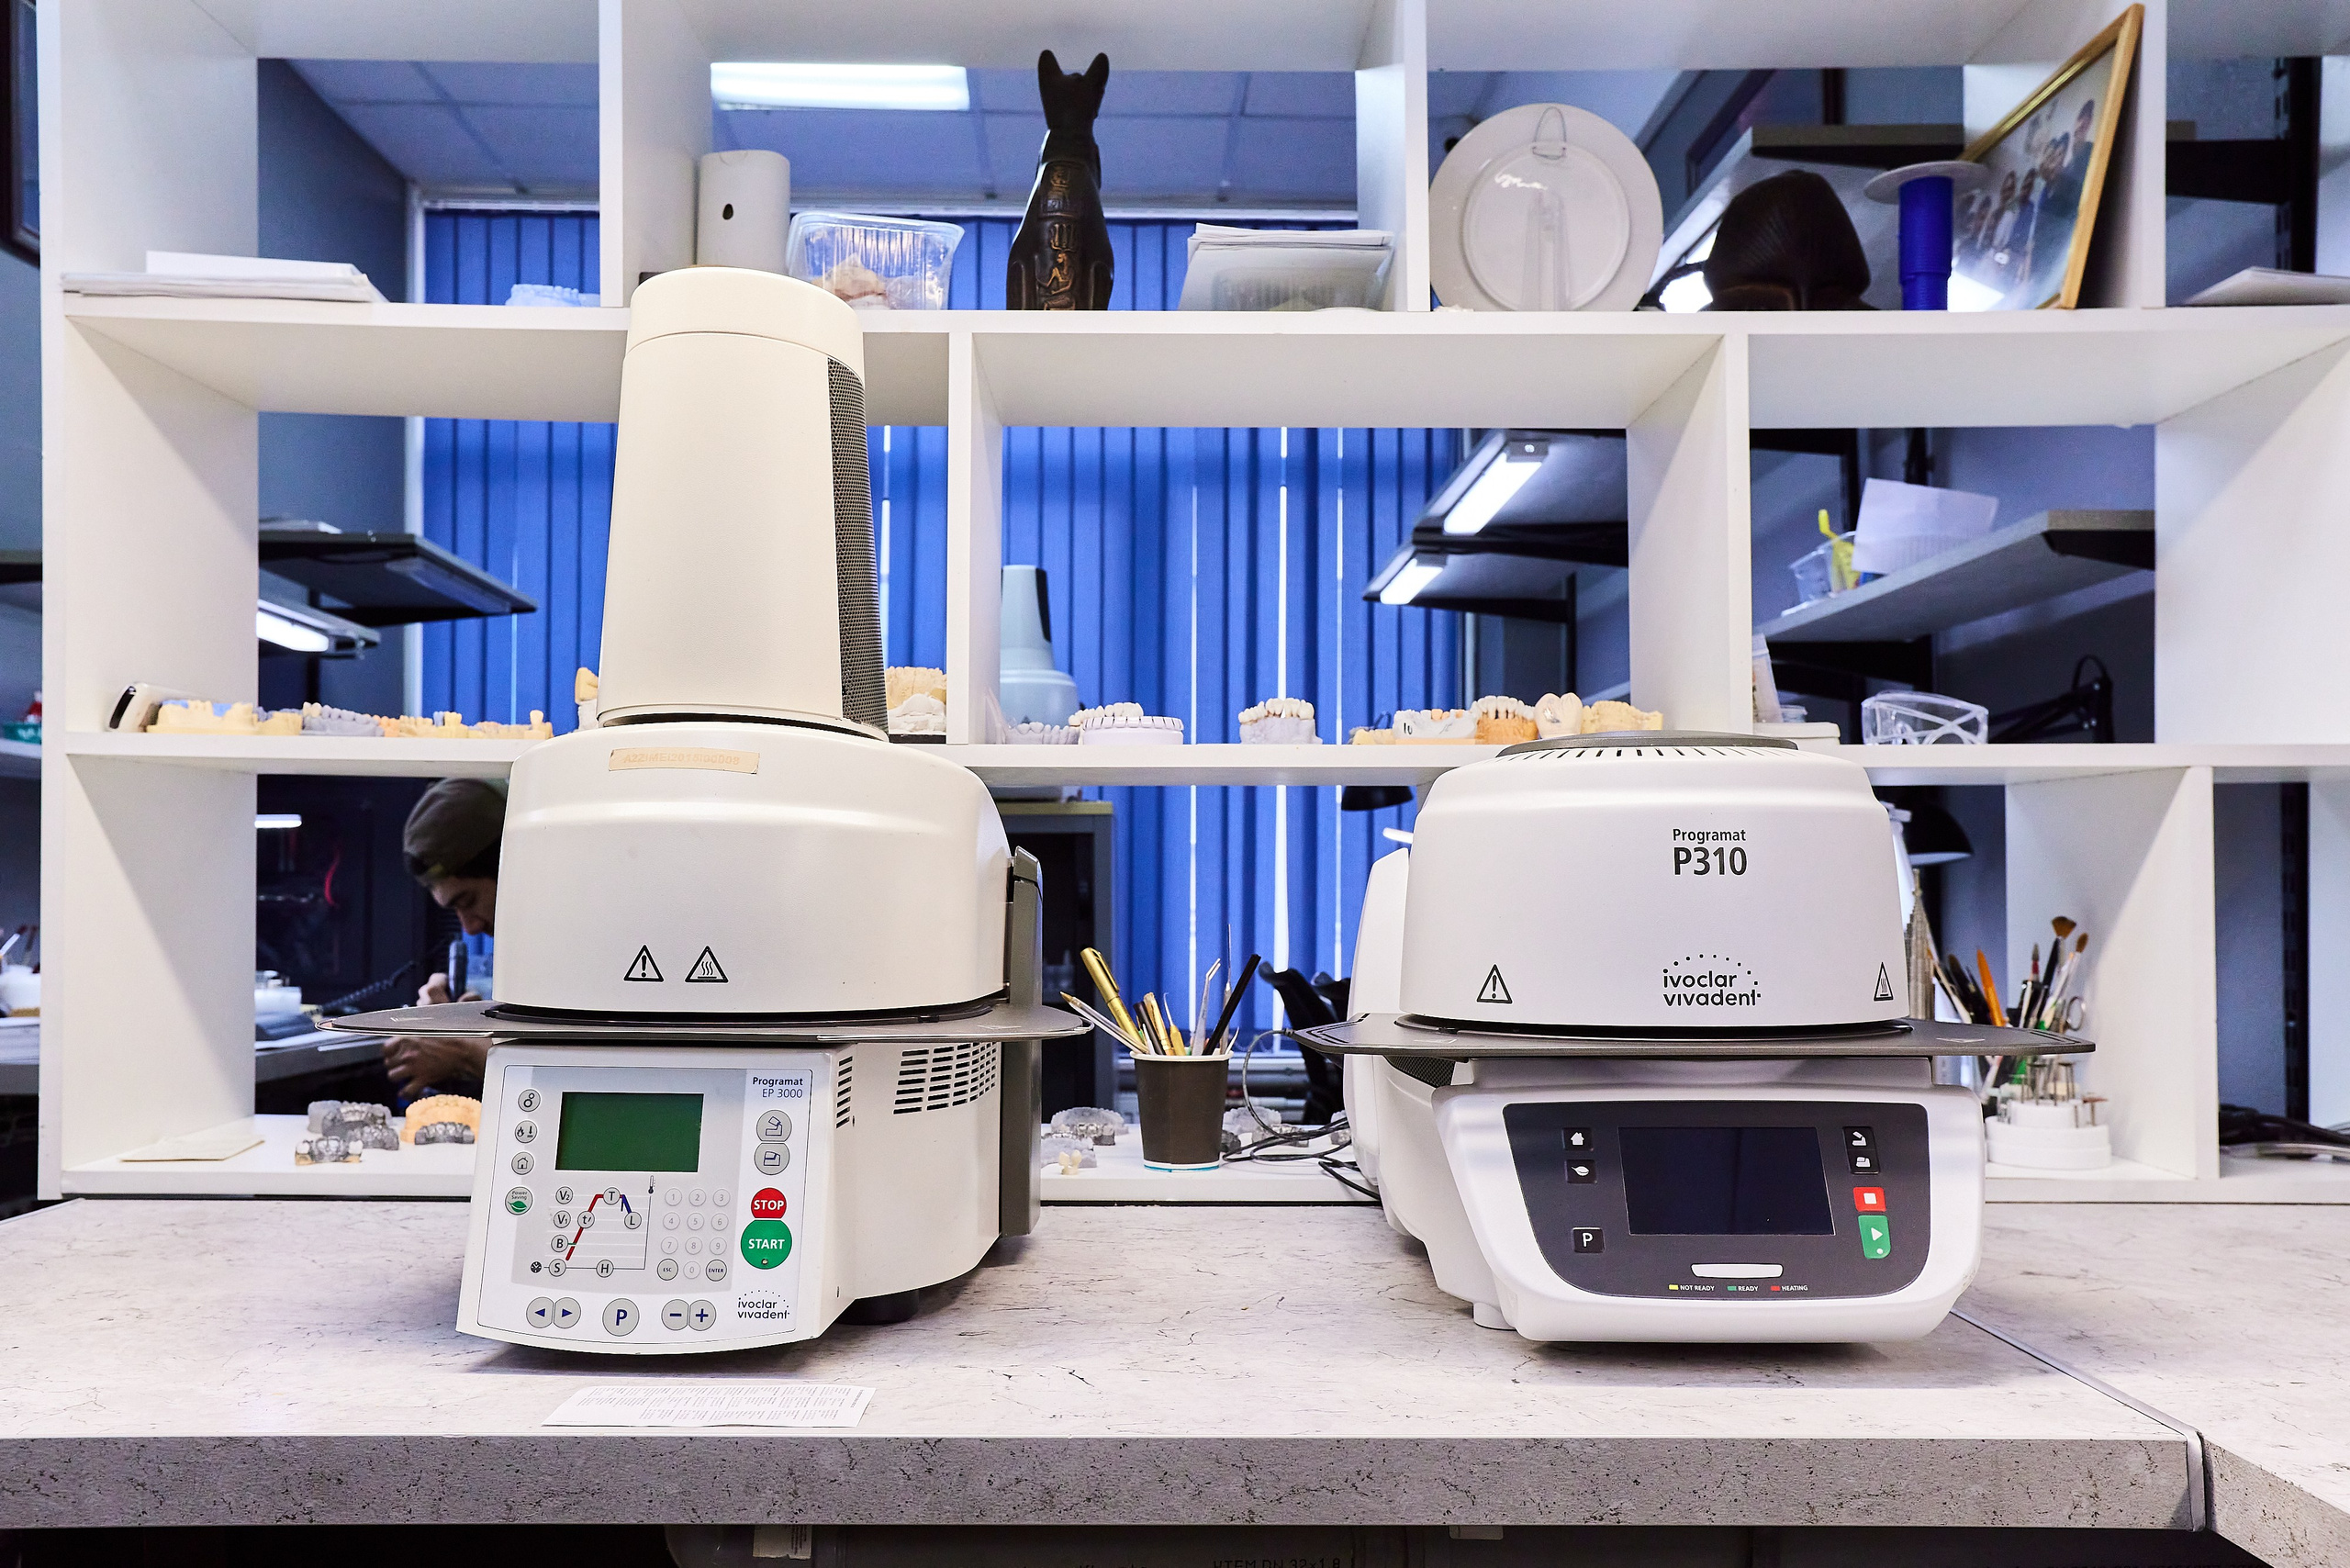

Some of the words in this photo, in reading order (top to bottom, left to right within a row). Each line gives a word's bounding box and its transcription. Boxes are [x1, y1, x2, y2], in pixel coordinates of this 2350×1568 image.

[1673, 828, 1747, 845] Programat
[1673, 846, 1748, 876] P310
[1662, 969, 1738, 988] ivoclar
[1662, 989, 1757, 1006] vivadent
[753, 1077, 803, 1087] Programat
[762, 1088, 775, 1098] EP
[777, 1088, 803, 1098] 3000
[609, 1191, 616, 1202] T
[695, 1193, 700, 1202] 2
[719, 1193, 724, 1202] 3
[753, 1199, 785, 1211] STOP
[629, 1215, 636, 1226] L
[693, 1217, 698, 1226] 5
[717, 1217, 722, 1226] 6
[556, 1238, 564, 1249] B
[690, 1241, 697, 1249] 8
[748, 1238, 786, 1249] START
[1582, 1232, 1594, 1248] P
[715, 1242, 721, 1250] 9
[554, 1262, 561, 1273] S
[600, 1263, 610, 1274] H
[689, 1266, 695, 1274] 0
[737, 1297, 778, 1309] ivoclar
[616, 1308, 628, 1326] P
[737, 1309, 788, 1319] vivadent
